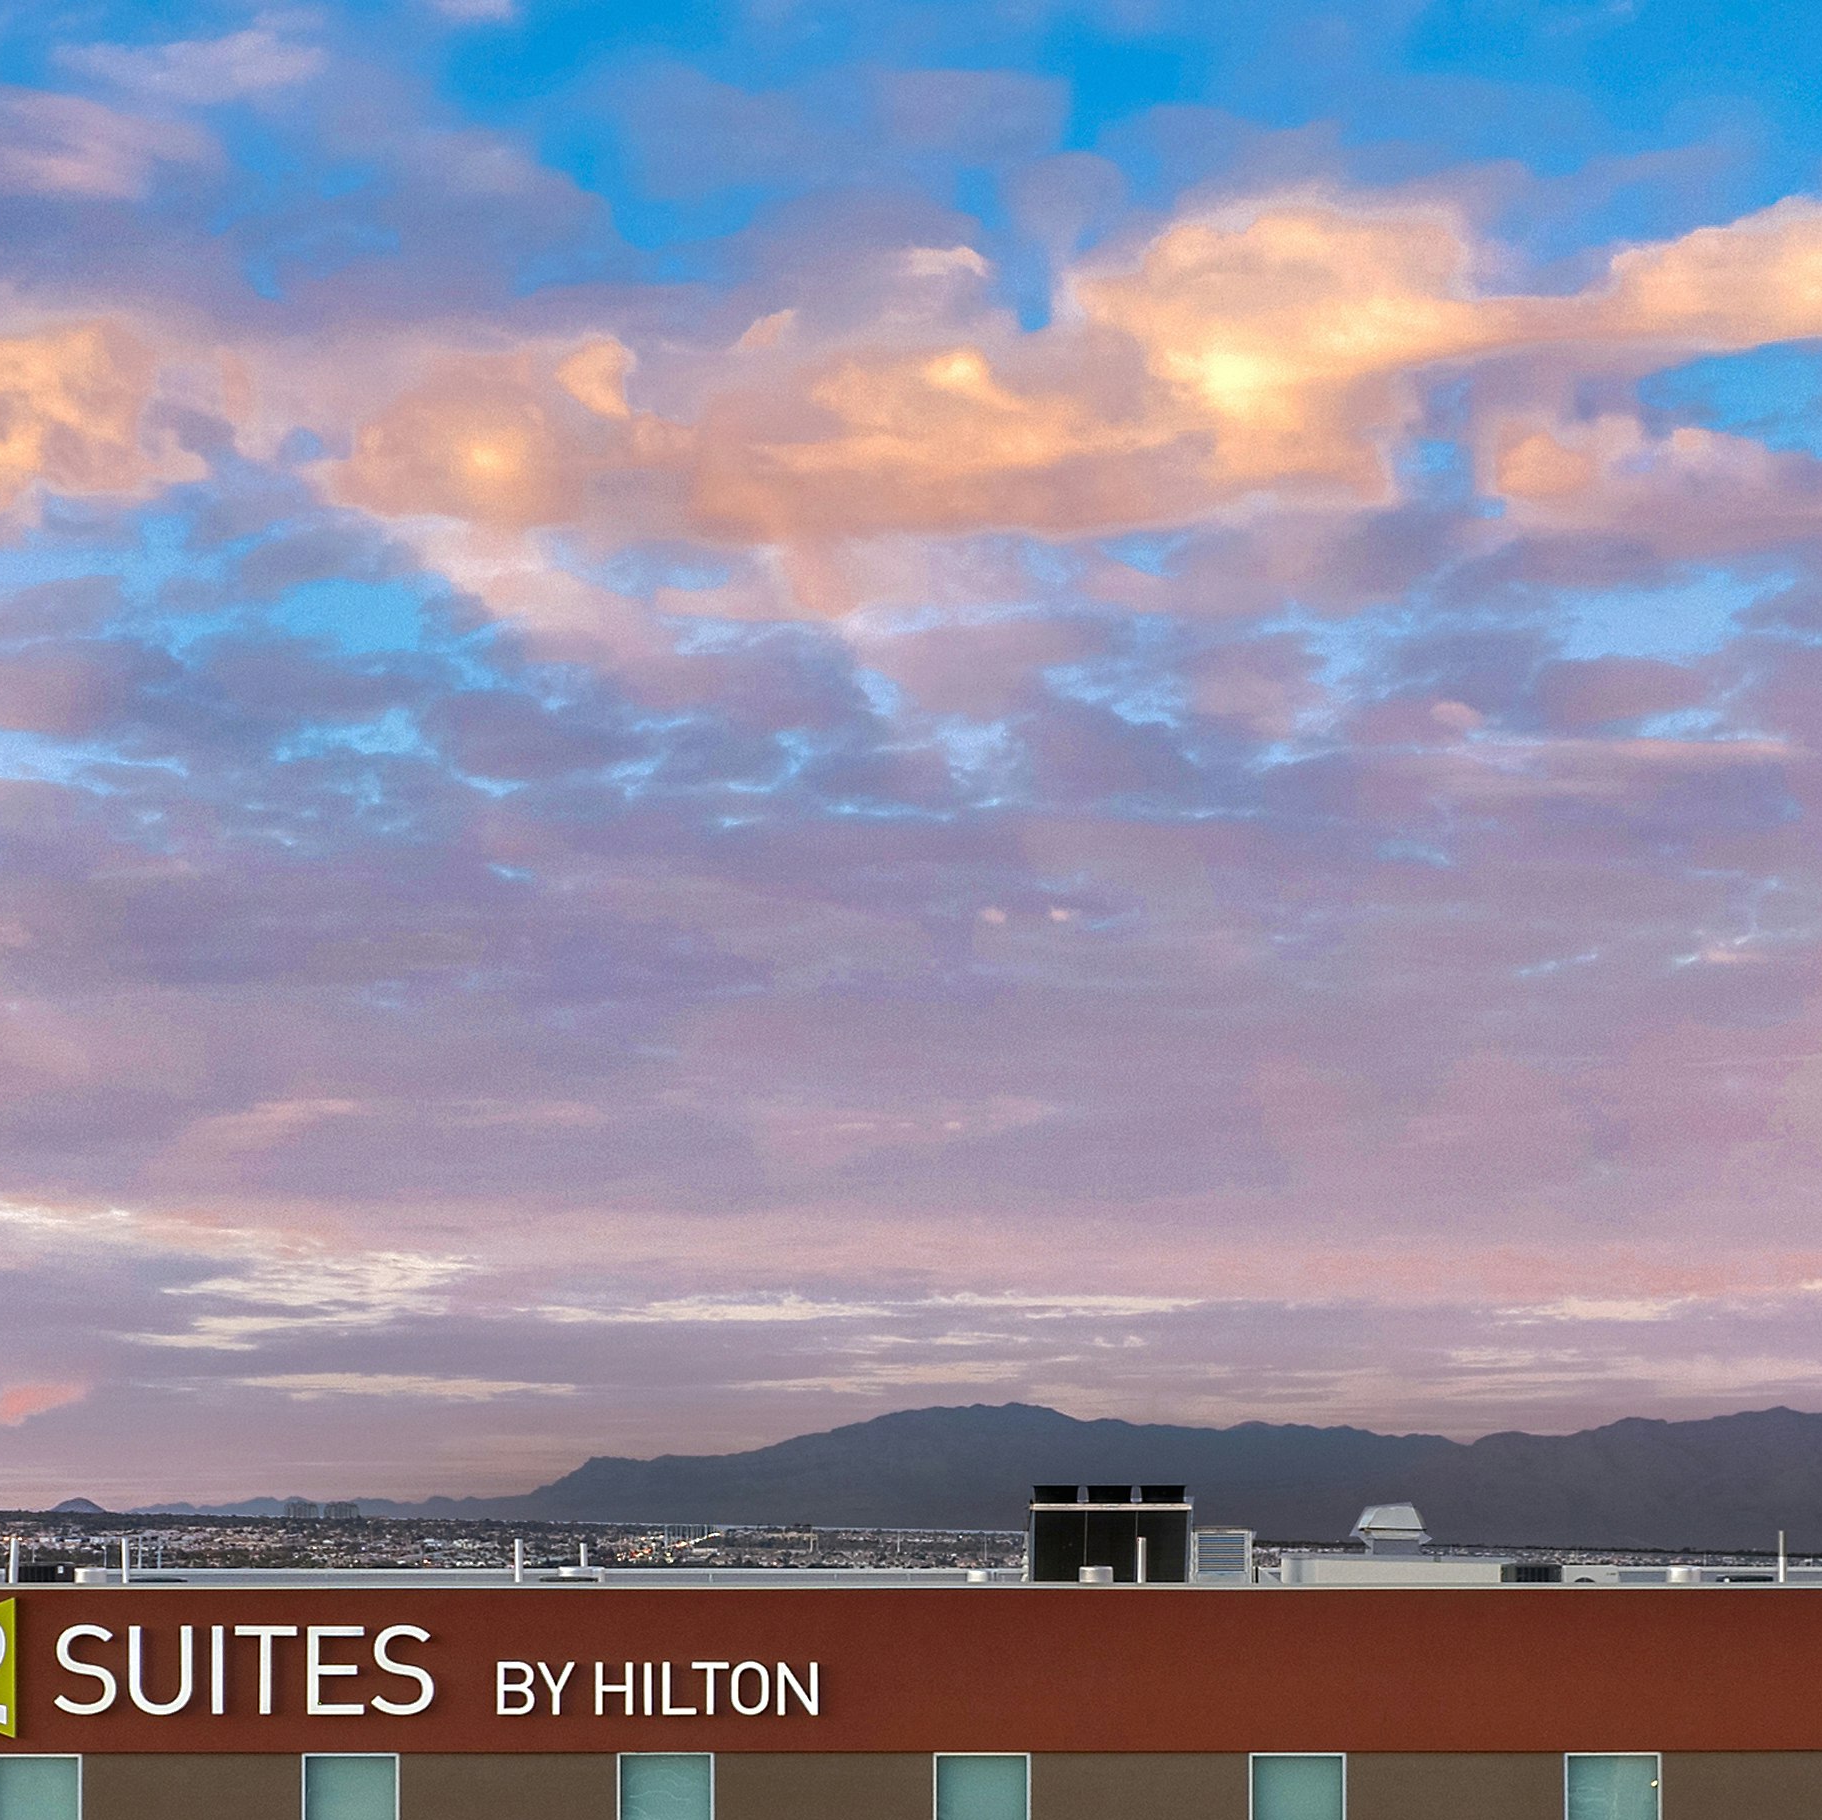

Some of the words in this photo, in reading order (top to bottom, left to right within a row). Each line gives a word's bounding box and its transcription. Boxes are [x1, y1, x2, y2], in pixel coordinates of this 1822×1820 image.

[52, 1623, 436, 1717] SUITES
[495, 1660, 575, 1717] BY
[595, 1660, 820, 1717] HILTON
